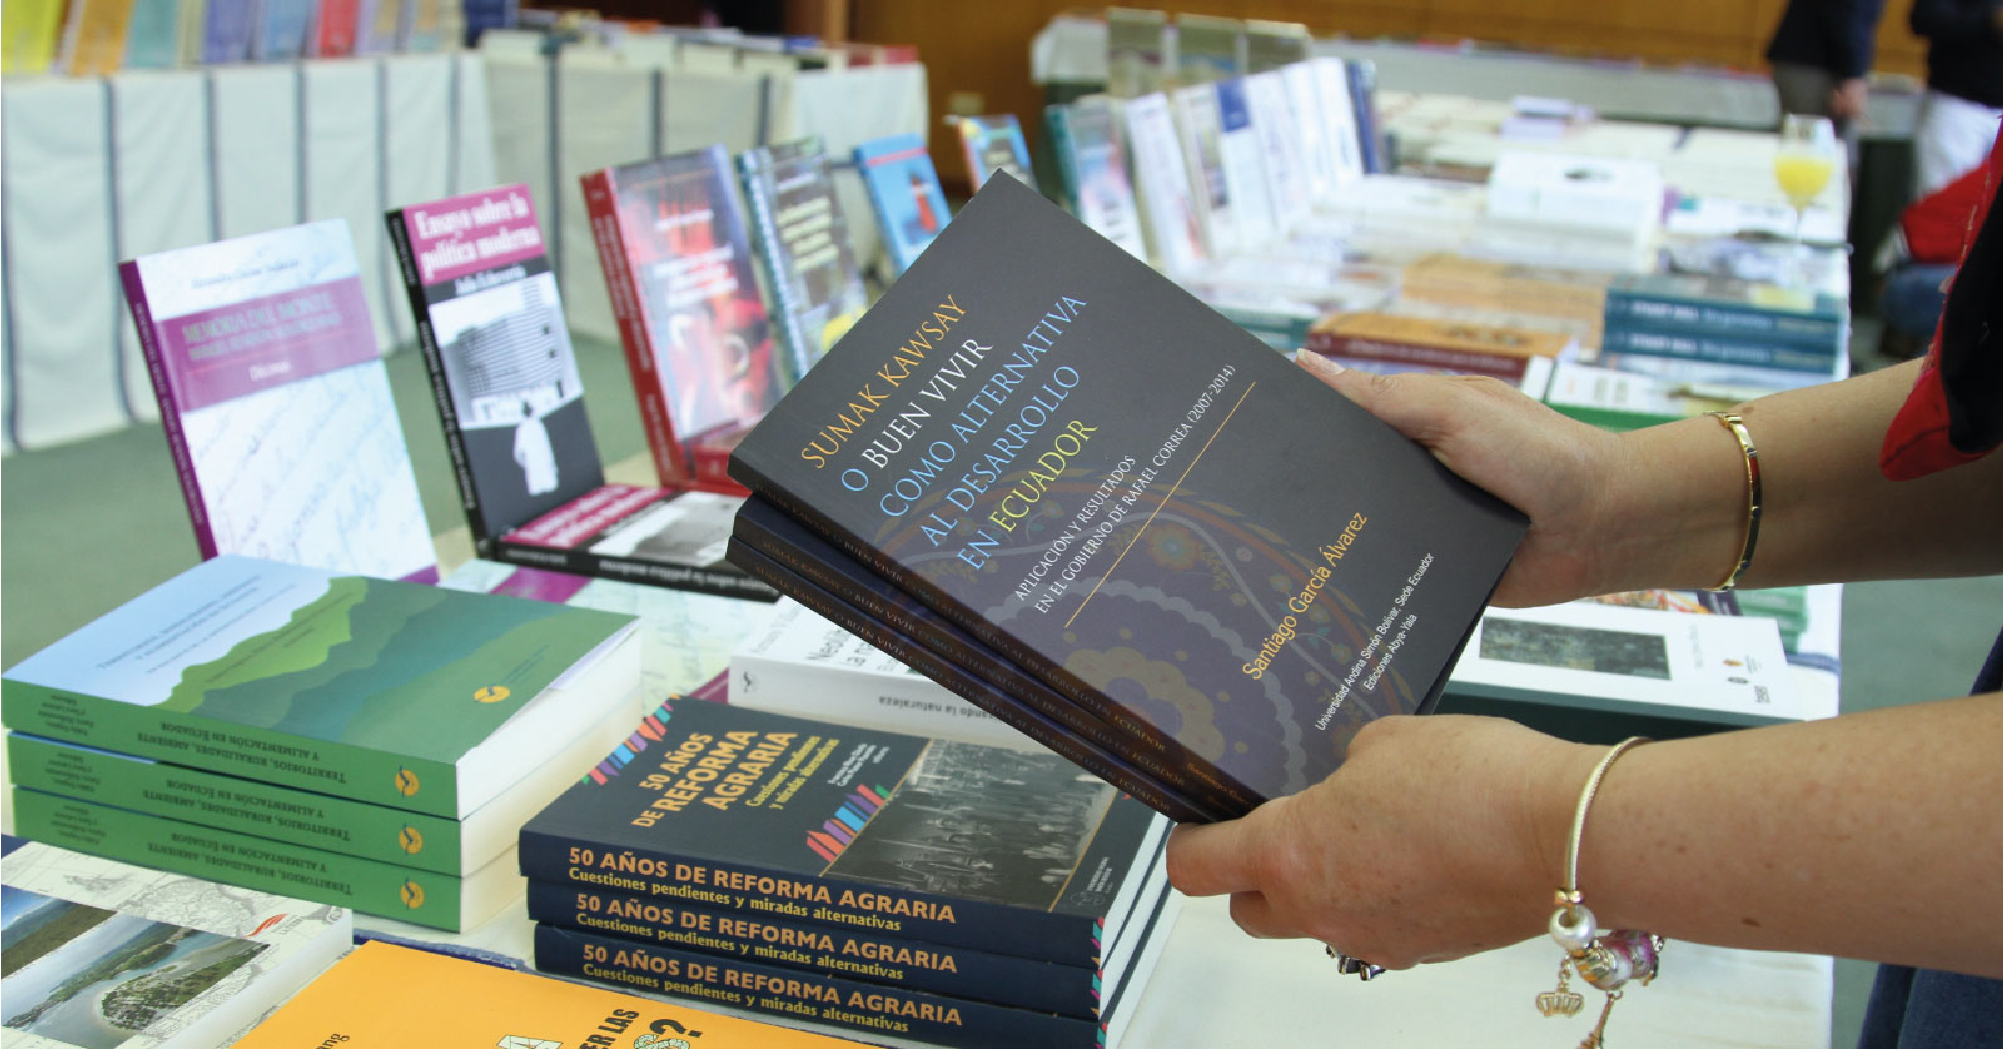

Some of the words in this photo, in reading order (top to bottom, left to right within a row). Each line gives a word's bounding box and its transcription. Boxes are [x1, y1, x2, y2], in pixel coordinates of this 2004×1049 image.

[414, 208, 472, 240] Ensayo
[471, 197, 512, 227] sobre
[509, 192, 530, 218] la
[476, 226, 541, 259] moderna
[801, 383, 891, 469] SUMAK
[877, 293, 968, 387] KAWSAY
[841, 467, 869, 492] O
[861, 400, 933, 469] BUEN
[919, 337, 994, 404] VIVIR
[879, 441, 957, 517] COMO
[951, 295, 1087, 445] ALTERNATIVA
[920, 508, 959, 548] AL
[957, 365, 1082, 512] DESARROLLO
[957, 528, 999, 571] EN
[988, 419, 1098, 533] ECUADOR
[1034, 593, 1055, 614] EN
[1051, 578, 1068, 596] EL
[1061, 518, 1114, 582] GOBIERNO
[1112, 502, 1129, 525] DE
[1121, 460, 1160, 507] RAFAEL
[1151, 421, 1193, 467] CORREA
[1186, 364, 1236, 424] (2007-2014)
[1075, 455, 1137, 526] RESULTADOS
[1015, 535, 1071, 601] APLICACIÓN
[1069, 525, 1082, 544] Y
[1242, 615, 1298, 681] Santiago
[1288, 562, 1332, 616] García
[1317, 511, 1368, 569] Álvarez
[842, 540, 873, 562] BUEN
[872, 559, 904, 583] VIVIR
[1025, 657, 1096, 705] DESARROLLO
[1112, 713, 1167, 752] ECUADOR
[1313, 683, 1351, 732] Universidad
[1342, 656, 1367, 687] Andina
[1359, 631, 1383, 661] Simón
[1375, 603, 1401, 636] Bolívar,
[1393, 582, 1415, 607] Sede
[1407, 550, 1436, 587] Ecuador
[1362, 650, 1393, 691] Ediciones
[845, 617, 876, 639] BUEN
[875, 635, 907, 658] VIVIR
[906, 653, 943, 679] COMO
[1117, 776, 1172, 812] ECUADOR
[853, 592, 885, 614] BUEN
[884, 610, 917, 633] VIVIR
[916, 628, 953, 654] COMO
[1130, 750, 1186, 787] ECUADOR
[879, 696, 942, 712] naturaleza
[945, 705, 957, 716] la
[631, 810, 665, 827] DE
[652, 731, 759, 811] REFORMA
[639, 773, 670, 790] 50
[660, 732, 714, 774] AÑOS
[701, 731, 798, 811] AGRARIA
[569, 846, 595, 868] 50
[599, 850, 668, 880] AÑOS
[674, 863, 707, 886] DE
[713, 867, 832, 906] REFORMA
[839, 889, 957, 925] AGRARIA
[569, 867, 645, 893] Cuestiones
[651, 879, 729, 906] pendientes
[735, 893, 745, 907] y
[751, 893, 808, 917] miradas
[812, 904, 902, 932] alternativas
[577, 893, 601, 913] 50
[607, 896, 675, 925] AÑOS
[679, 909, 712, 930] DE
[718, 913, 834, 953] REFORMA
[840, 936, 959, 975] AGRARIA
[577, 912, 652, 939] Cuestiones
[658, 925, 734, 953] pendientes
[741, 940, 751, 953] y
[755, 940, 811, 963] miradas
[814, 952, 904, 981] alternativas
[583, 944, 608, 963] 50
[613, 947, 682, 977] AÑOS
[688, 961, 719, 984] DE
[725, 965, 842, 1005] REFORMA
[848, 989, 963, 1027] AGRARIA
[583, 963, 660, 990] Cuestiones
[664, 977, 741, 1005] pendientes
[747, 992, 757, 1006] y
[760, 993, 817, 1016] miradas
[821, 1004, 911, 1033] alternativas
[597, 1009, 640, 1034] LAS
